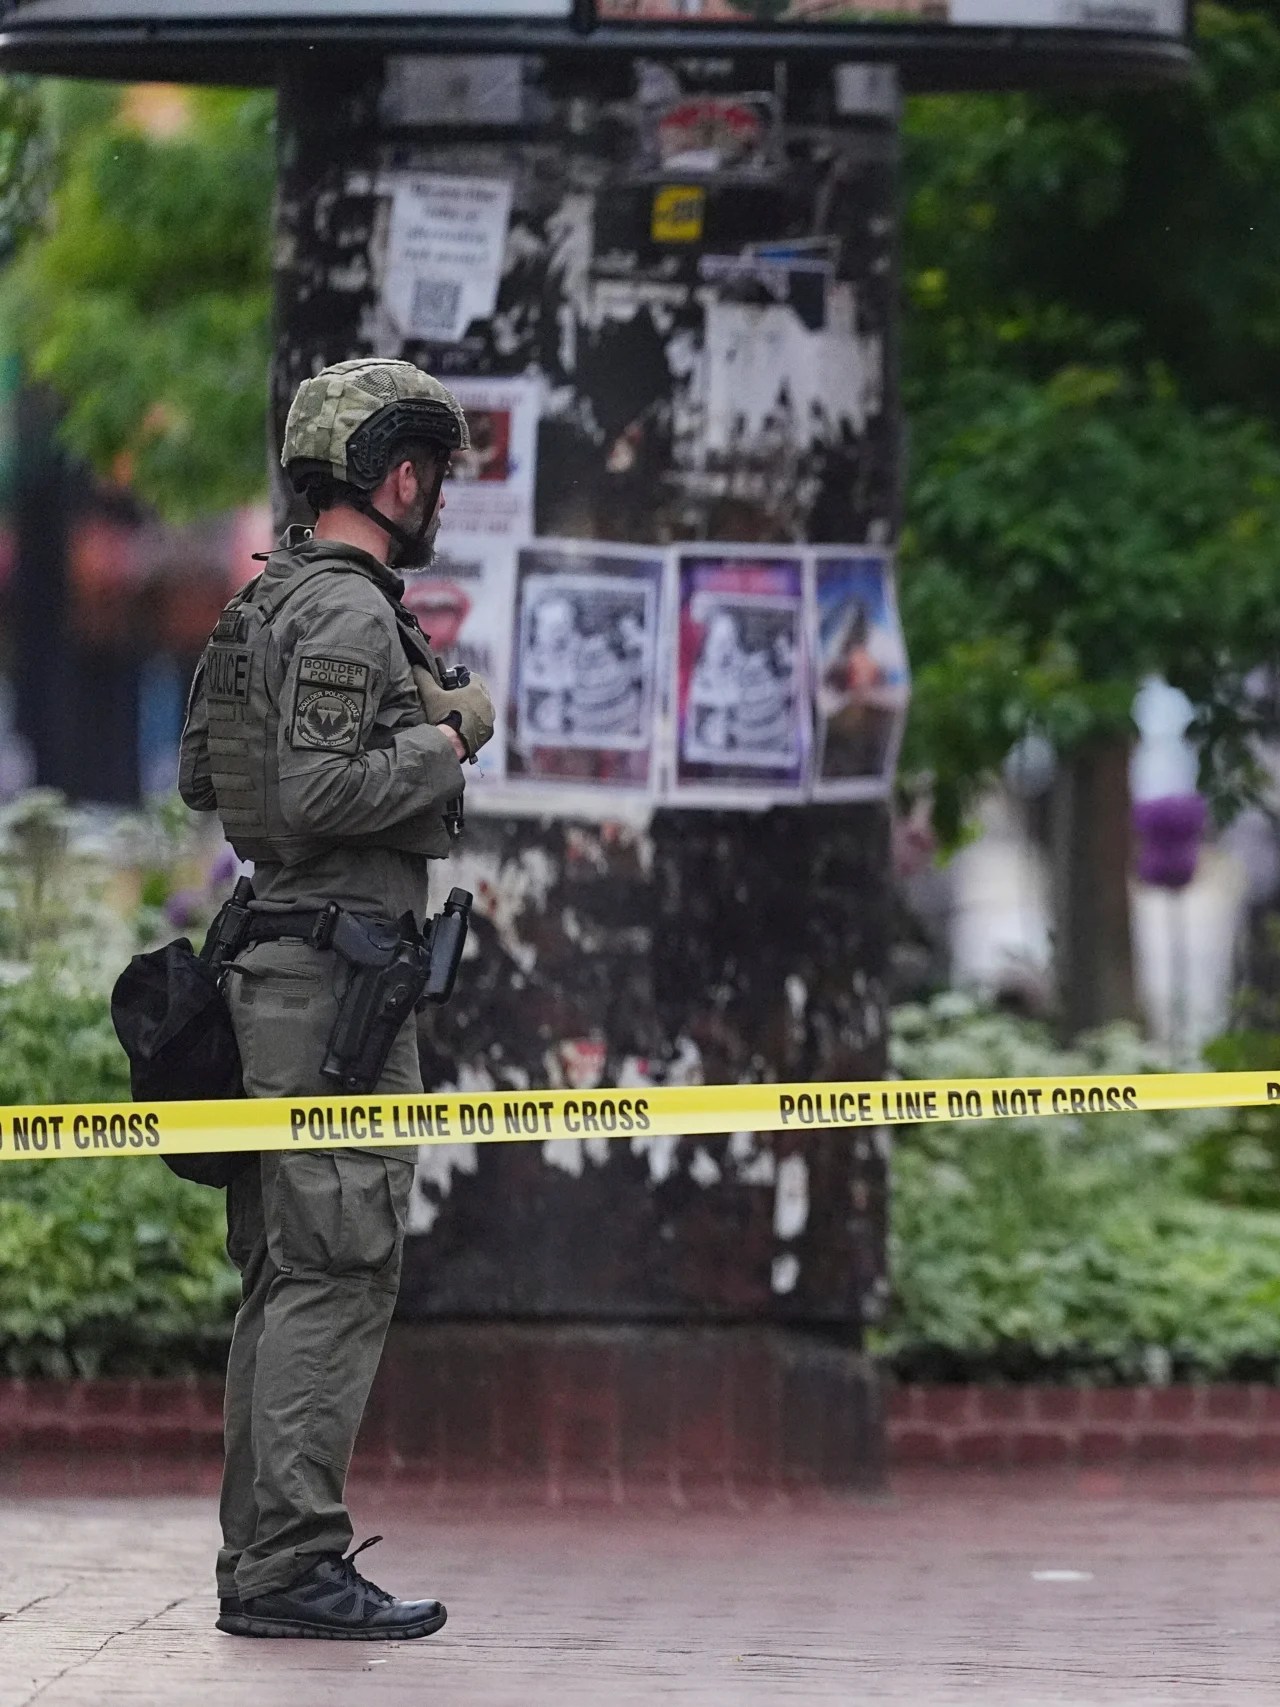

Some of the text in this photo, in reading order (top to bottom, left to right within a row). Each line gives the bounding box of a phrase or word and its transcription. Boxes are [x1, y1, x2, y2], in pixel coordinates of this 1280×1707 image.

[304, 660, 363, 676] BOULDER
[310, 671, 355, 686] POLICE
[324, 690, 348, 702] POLICE
[779, 1086, 1138, 1124] POLICE LINE DO NOT CROSS
[13, 1116, 63, 1151] NOT
[73, 1112, 160, 1150] CROSS
[290, 1099, 650, 1140] POLICE LINE DO NOT CROSS
